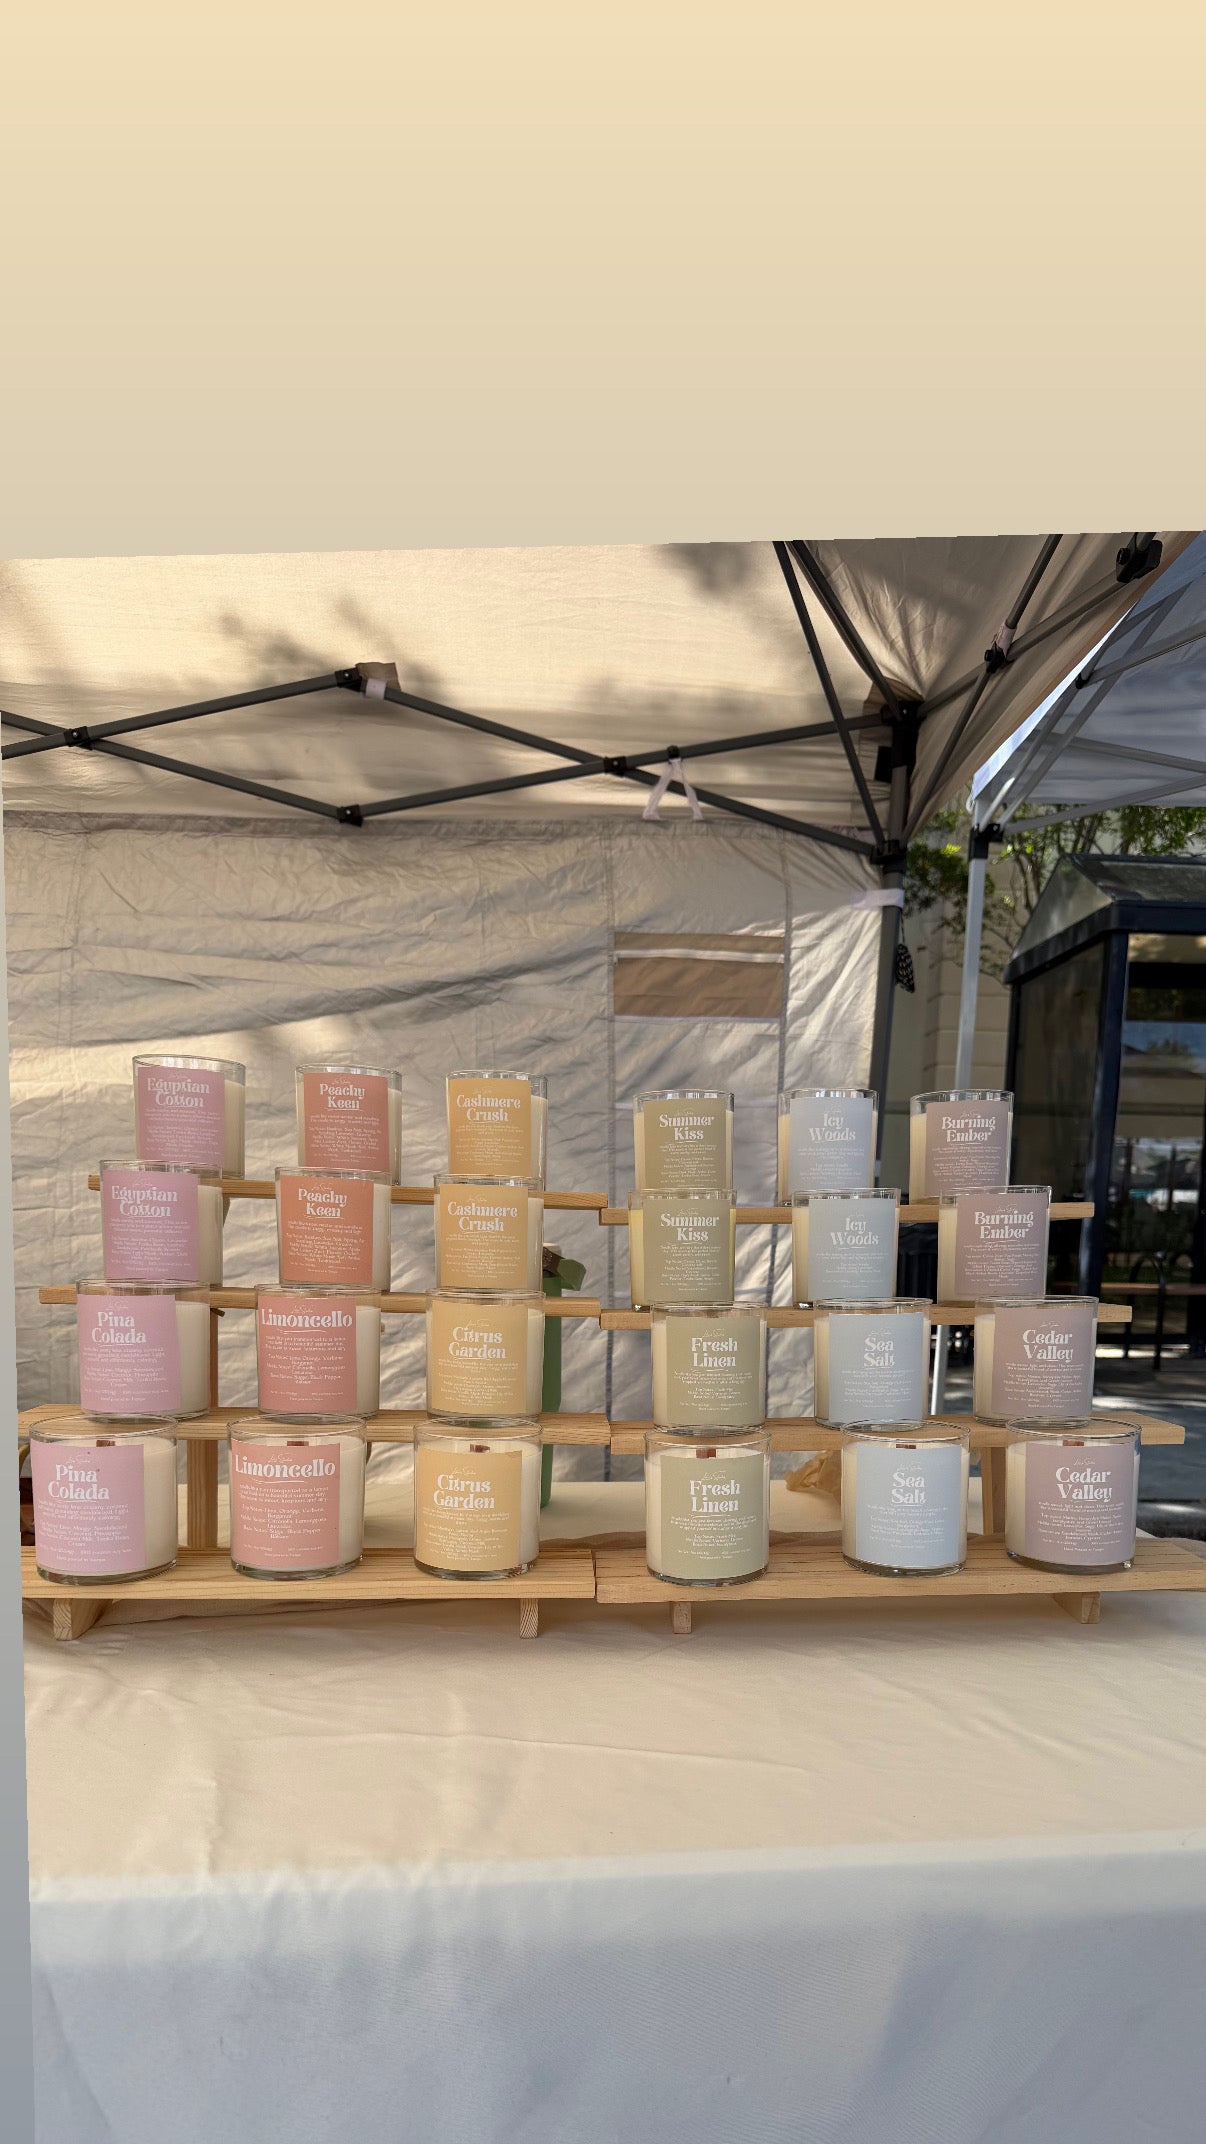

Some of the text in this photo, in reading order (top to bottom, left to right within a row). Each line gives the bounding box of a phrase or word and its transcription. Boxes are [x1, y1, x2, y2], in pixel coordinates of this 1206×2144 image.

[147, 1078, 209, 1098] Egyptian
[320, 1084, 365, 1100] Peachy
[156, 1090, 204, 1107] Cotton
[328, 1097, 360, 1109] Keen
[456, 1094, 521, 1109] Cashmere
[466, 1109, 509, 1122] Crush
[659, 1114, 714, 1128] Summer
[823, 1113, 844, 1129] Icy
[942, 1114, 995, 1130] Burning
[674, 1127, 704, 1140] Kiss
[809, 1127, 856, 1141] Woods
[946, 1130, 992, 1142] Ember
[112, 1185, 177, 1205] Egyptian
[298, 1188, 347, 1207] Peachy
[120, 1202, 171, 1217] Cotton
[306, 1202, 341, 1217] Keen
[448, 1202, 518, 1217] Cashmere
[459, 1217, 504, 1231] Crush
[660, 1213, 719, 1227] Summer
[845, 1217, 866, 1234] Icy
[974, 1211, 1034, 1227] Burning
[677, 1227, 708, 1241] Kiss
[830, 1232, 879, 1245] Woods
[980, 1226, 1030, 1239] Ember
[97, 1312, 135, 1327] Pina
[261, 1309, 352, 1328] Limoncello
[91, 1327, 146, 1344] Colada
[452, 1326, 503, 1343] Citrus
[1022, 1329, 1073, 1344] Cedar
[448, 1341, 506, 1358] Garden
[691, 1337, 738, 1352] Fresh
[864, 1336, 894, 1352] Sea
[693, 1352, 736, 1367] Linen
[863, 1352, 895, 1367] Salt
[1023, 1344, 1074, 1363] Valley
[55, 1464, 98, 1483] Pina
[235, 1454, 336, 1478] Limoncello
[892, 1471, 925, 1488] Sea
[1055, 1466, 1111, 1483] Cedar
[48, 1481, 110, 1500] Colada
[437, 1474, 491, 1493] Citrus
[689, 1479, 740, 1496] Fresh
[433, 1490, 495, 1509] Garden
[891, 1488, 927, 1505] Salt
[1057, 1483, 1112, 1503] Valley
[691, 1496, 739, 1513] Linen
